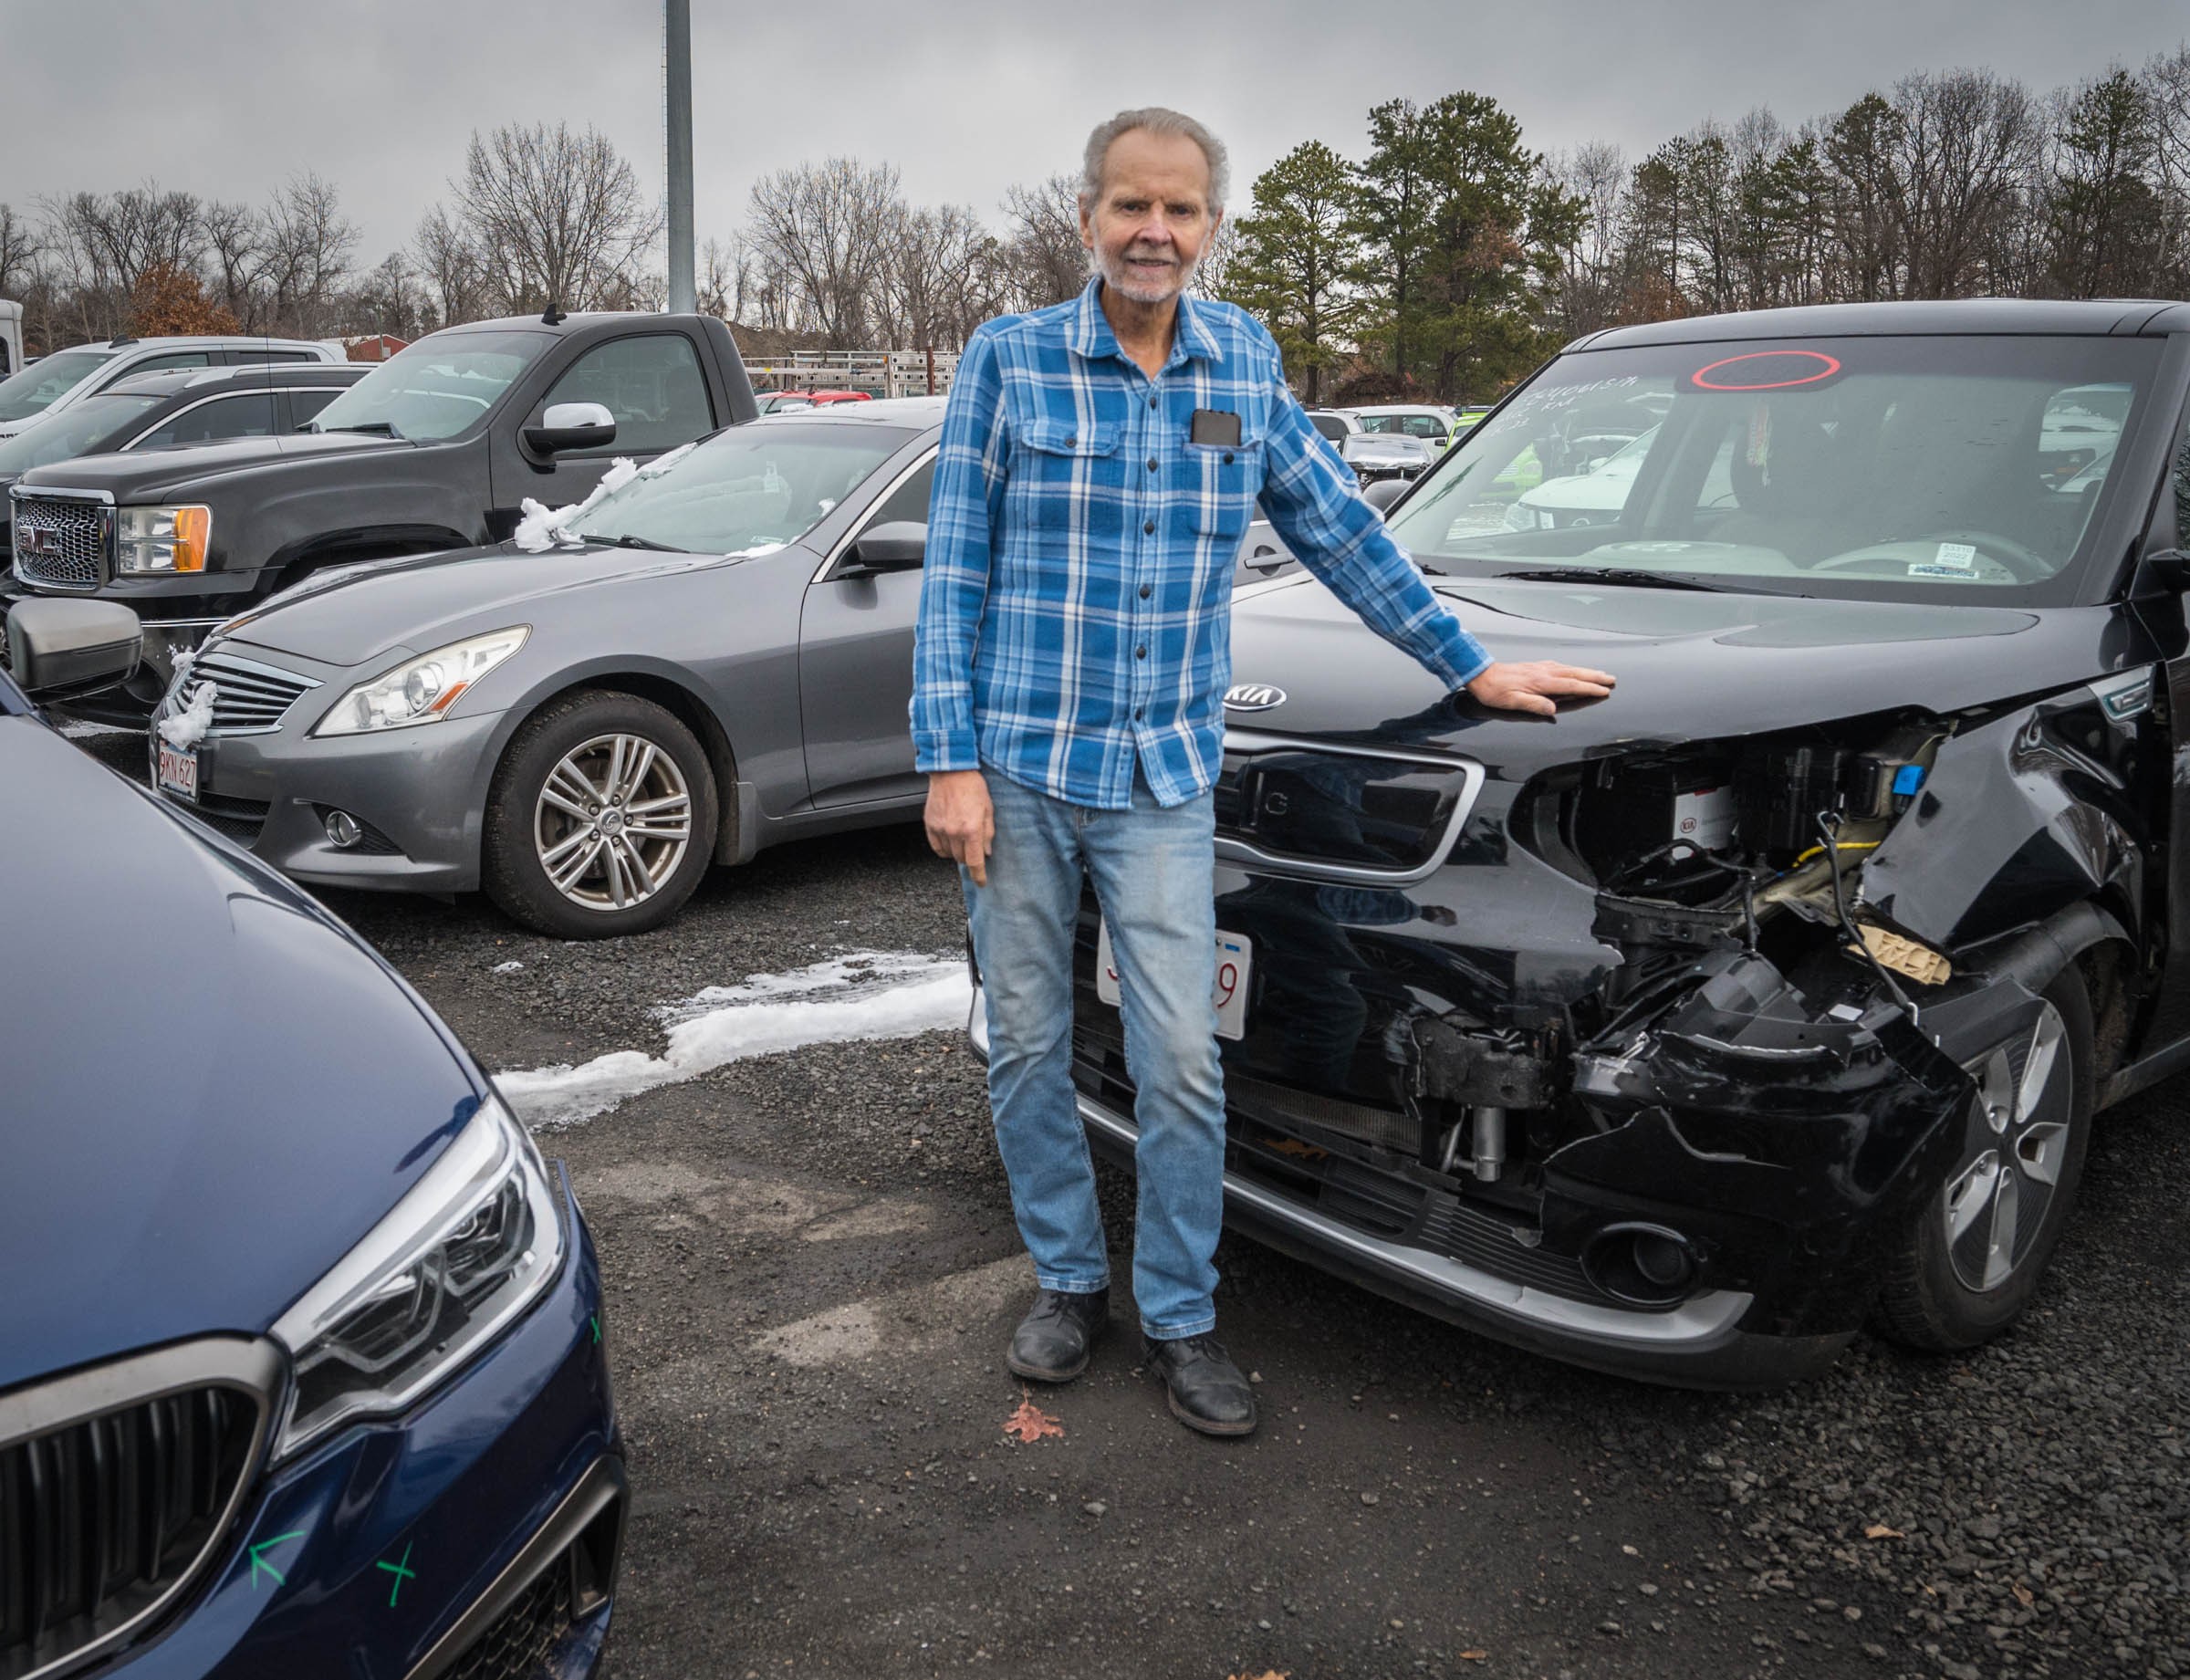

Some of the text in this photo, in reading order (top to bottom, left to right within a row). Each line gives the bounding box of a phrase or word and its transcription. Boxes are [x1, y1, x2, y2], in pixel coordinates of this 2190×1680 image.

[1224, 685, 1274, 705] KIA
[160, 751, 197, 788] 9KN 627
